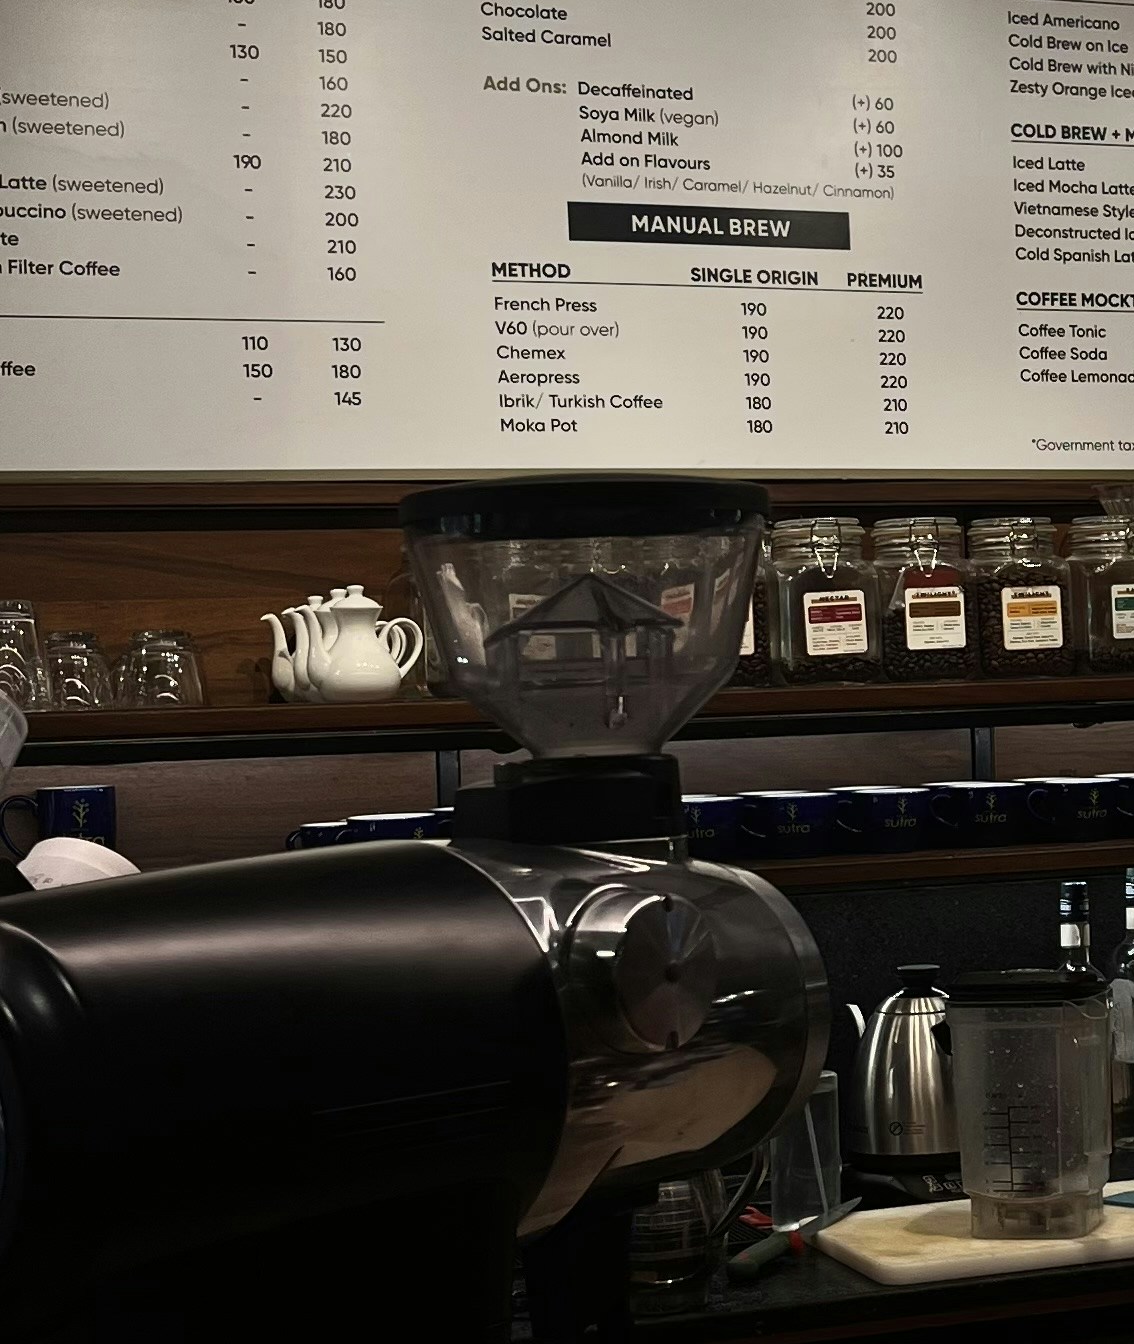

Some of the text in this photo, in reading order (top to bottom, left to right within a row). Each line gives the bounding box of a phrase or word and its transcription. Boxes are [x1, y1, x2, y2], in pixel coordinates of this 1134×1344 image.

[866, 2, 895, 17] 200
[1008, 11, 1039, 25] Iced
[1043, 13, 1120, 30] Americano
[482, 26, 897, 63] Salted Caramel 200
[483, 76, 520, 92] Add
[526, 78, 567, 94] Ons:
[578, 81, 693, 100] Decaffeinated
[875, 97, 894, 111] 60
[12, 115, 125, 138] (sweetened)
[1011, 123, 1056, 138] COLD
[1061, 125, 1107, 141] BREW
[0, 174, 163, 195] Latte (sweetened)
[582, 173, 894, 200] (Vanilla/ Irish/ Caramel/ Hazelnut/ Cinnamon)
[72, 203, 182, 224] (sweetened)
[1014, 201, 1099, 217] Vietnamese
[632, 215, 790, 237] MANUAL BREW
[8, 259, 356, 281] Filter Coffee 160
[492, 262, 922, 289] METHOD SINGLE ORIGIN PREMIUM
[495, 297, 904, 320] French Press 190 220
[1016, 291, 1077, 307] COFFEE
[1018, 324, 1065, 337] Coffee
[1069, 324, 1106, 338] Tonic
[243, 364, 361, 379] 150 180
[498, 370, 907, 389] Aeropress 190 220
[501, 418, 909, 434] Moka Pot 180 210
[686, 826, 715, 839] utra
